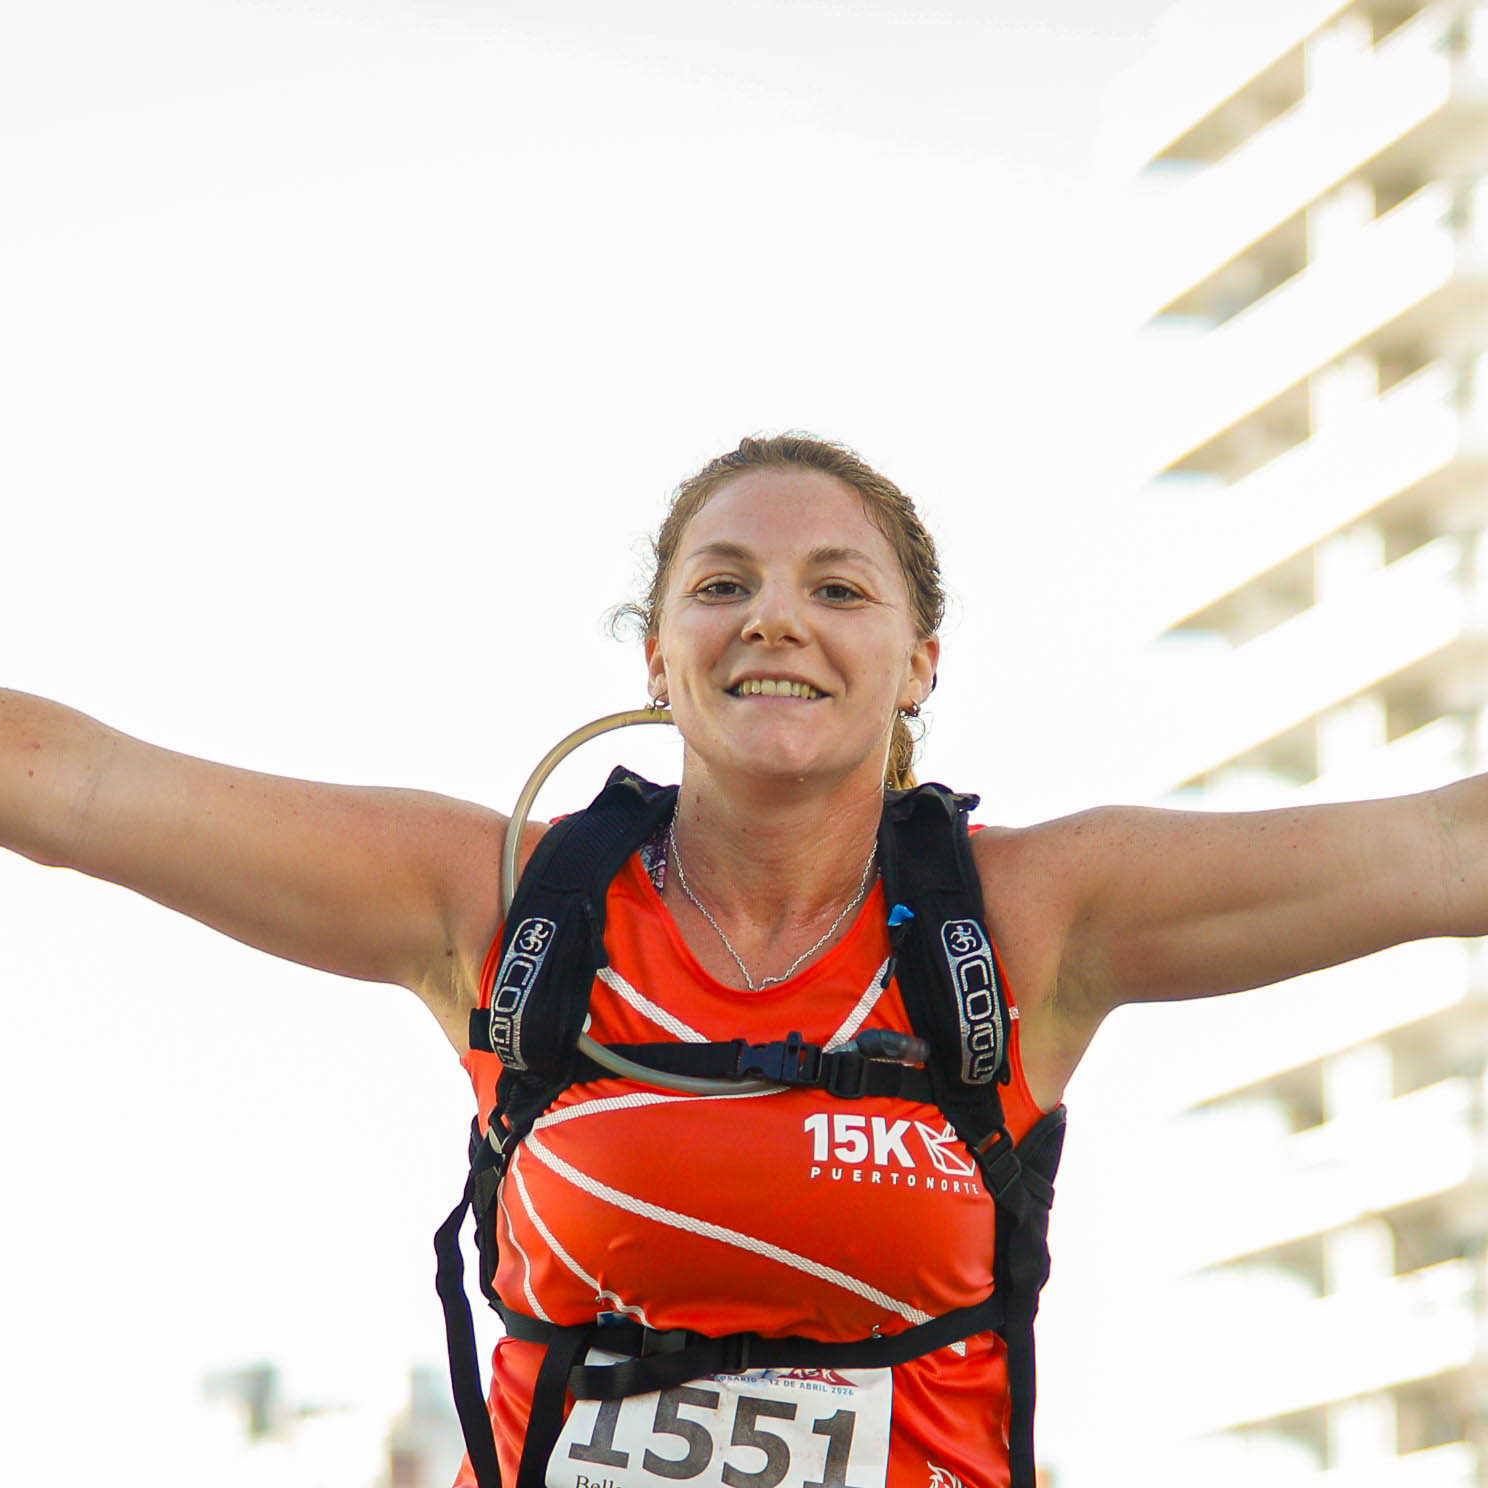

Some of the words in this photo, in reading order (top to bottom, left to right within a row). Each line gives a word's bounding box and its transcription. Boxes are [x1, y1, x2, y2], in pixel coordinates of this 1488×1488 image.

[804, 1113, 916, 1168] 15K
[810, 1167, 916, 1187] PUERTO
[783, 1380, 796, 1389] DE
[799, 1382, 827, 1393] ABRIL
